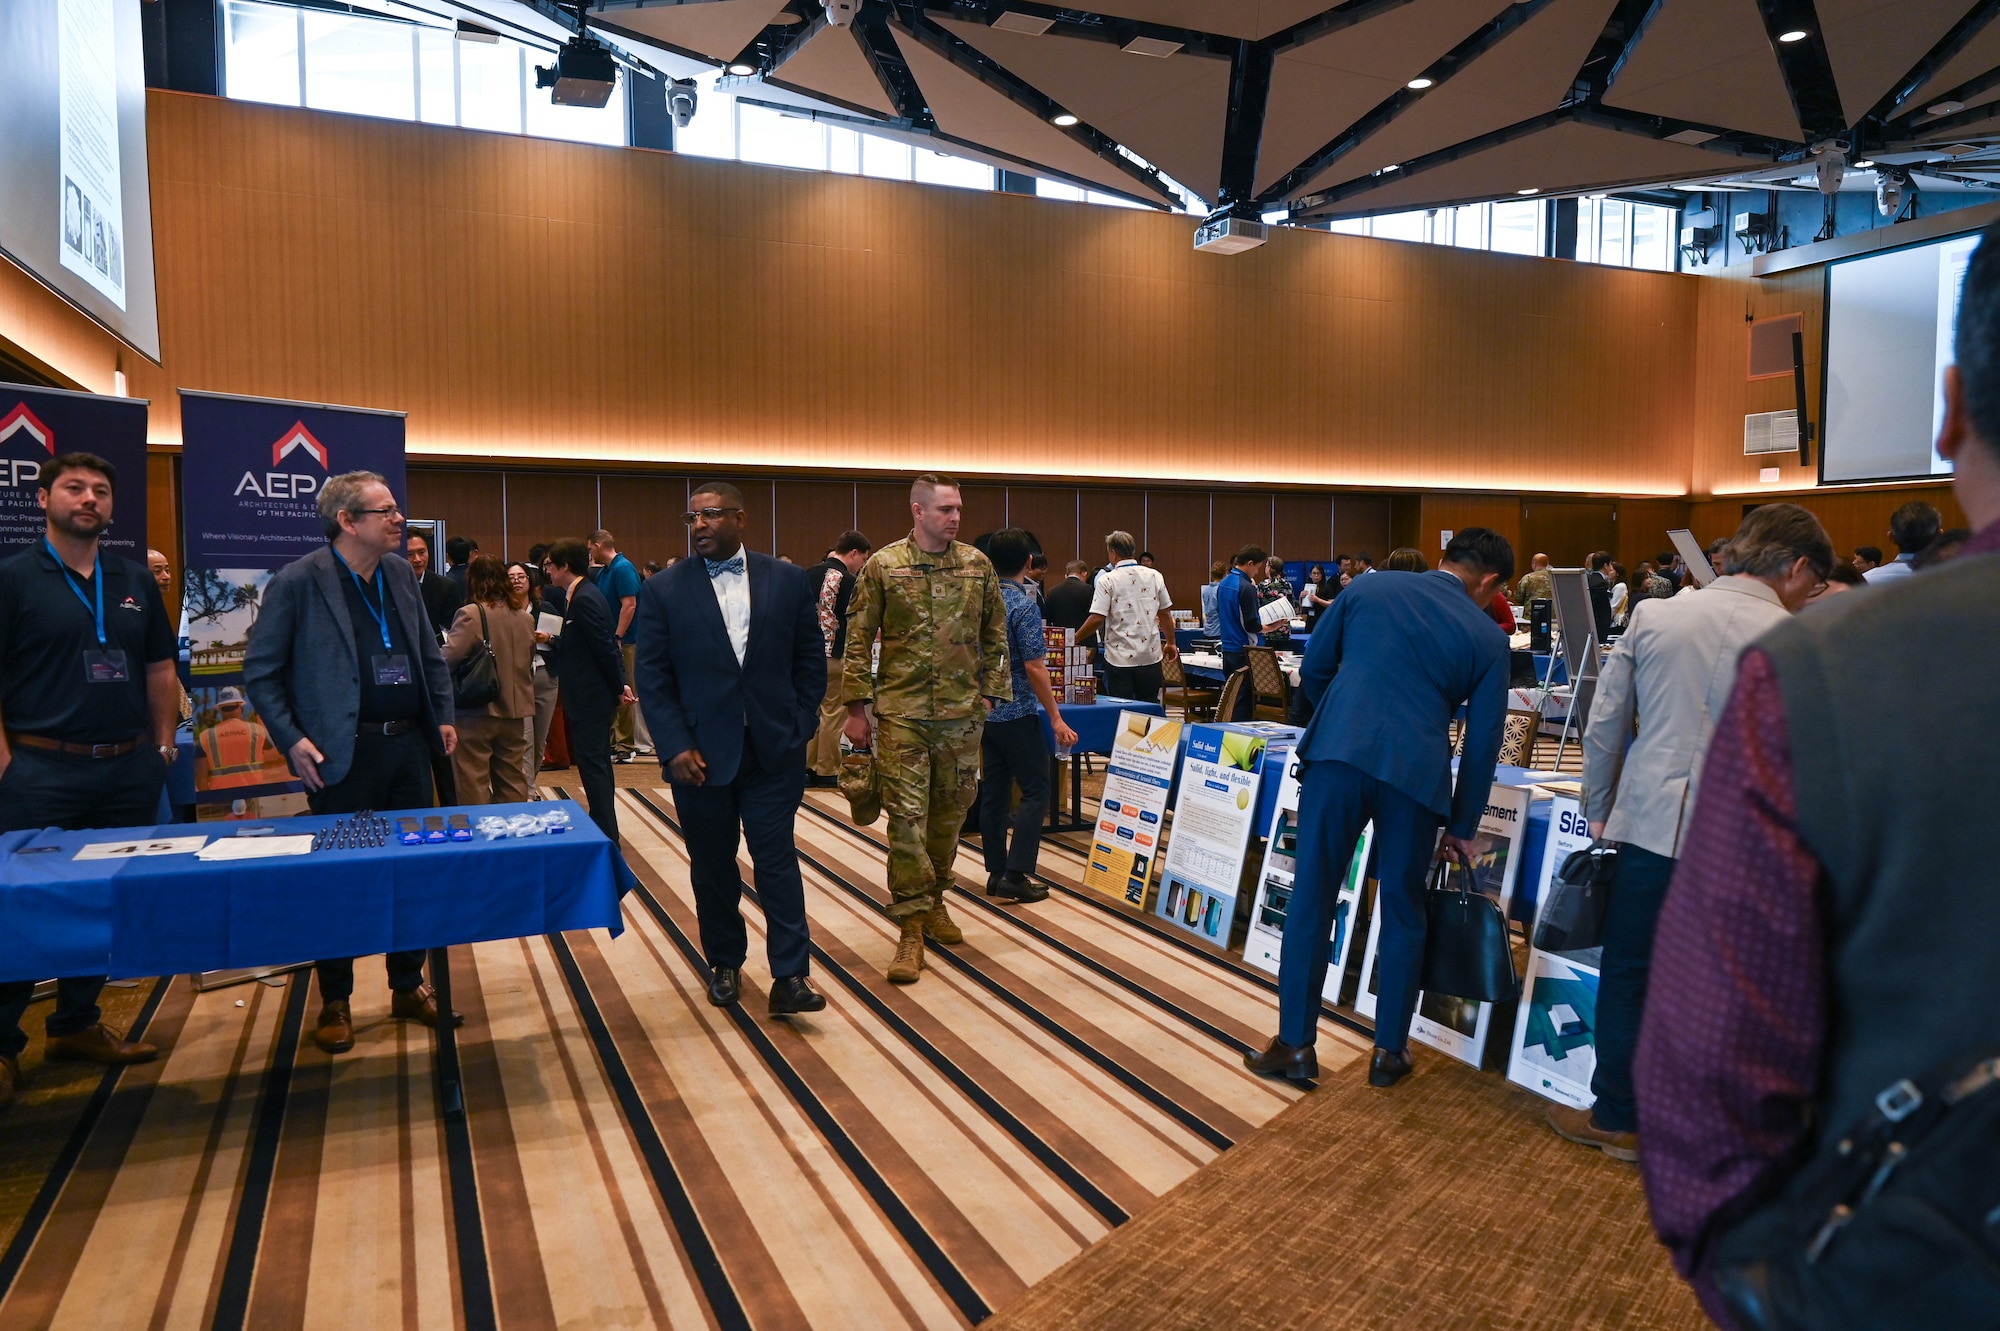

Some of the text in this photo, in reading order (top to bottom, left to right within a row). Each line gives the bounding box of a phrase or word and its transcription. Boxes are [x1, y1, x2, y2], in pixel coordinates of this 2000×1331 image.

[239, 501, 299, 509] ARCHITECTURE
[202, 532, 226, 540] Where
[227, 534, 258, 542] Visionary
[1219, 771, 1231, 781] and
[1231, 772, 1251, 787] flexible
[108, 843, 173, 854] 45
